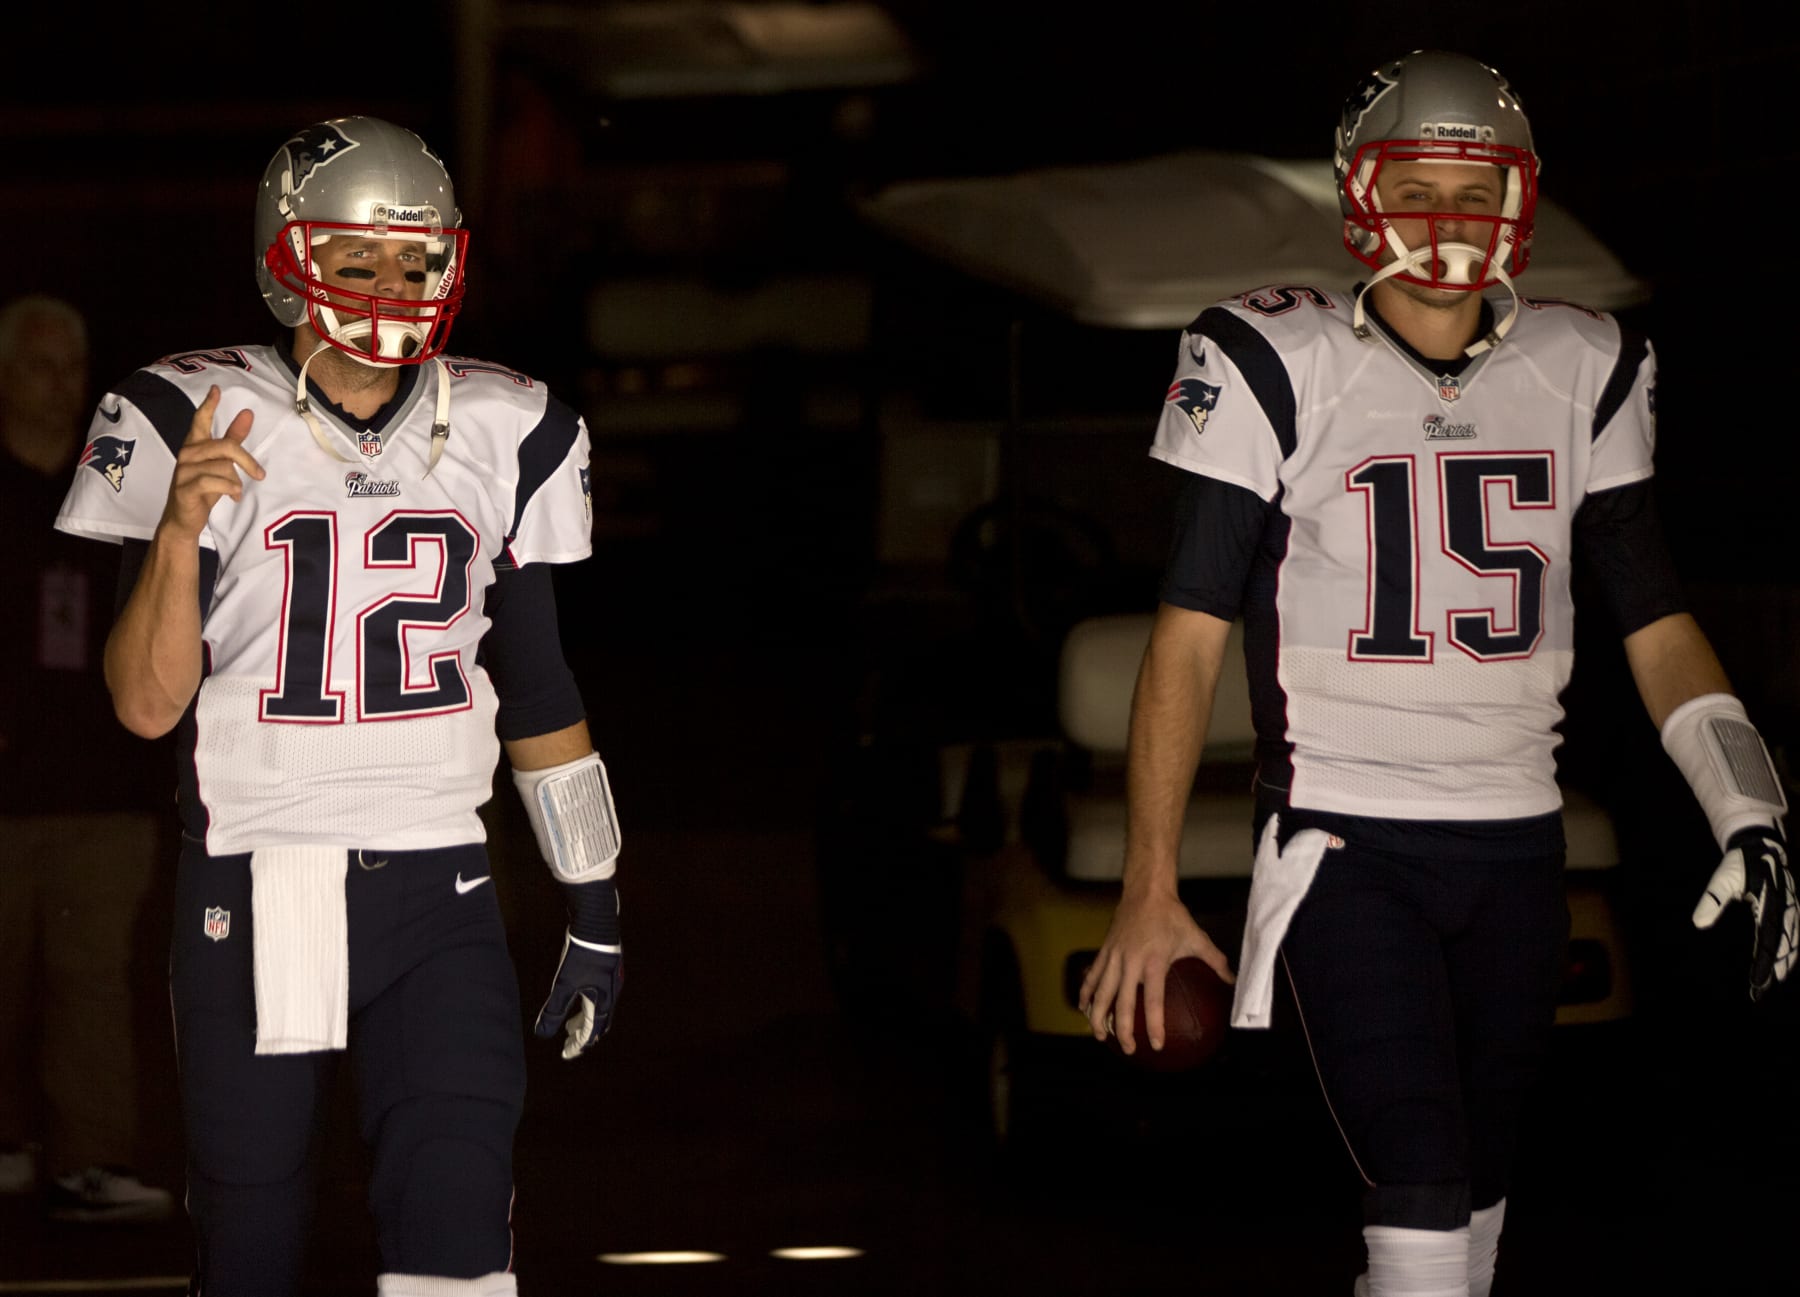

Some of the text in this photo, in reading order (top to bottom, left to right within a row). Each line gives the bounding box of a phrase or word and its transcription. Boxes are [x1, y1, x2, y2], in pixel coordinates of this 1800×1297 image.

[1438, 126, 1476, 139] Riddell
[387, 208, 424, 222] Riddell
[361, 442, 381, 455] NFL
[345, 480, 401, 498] Patriots
[1345, 449, 1556, 664] 15
[258, 508, 480, 725] 12
